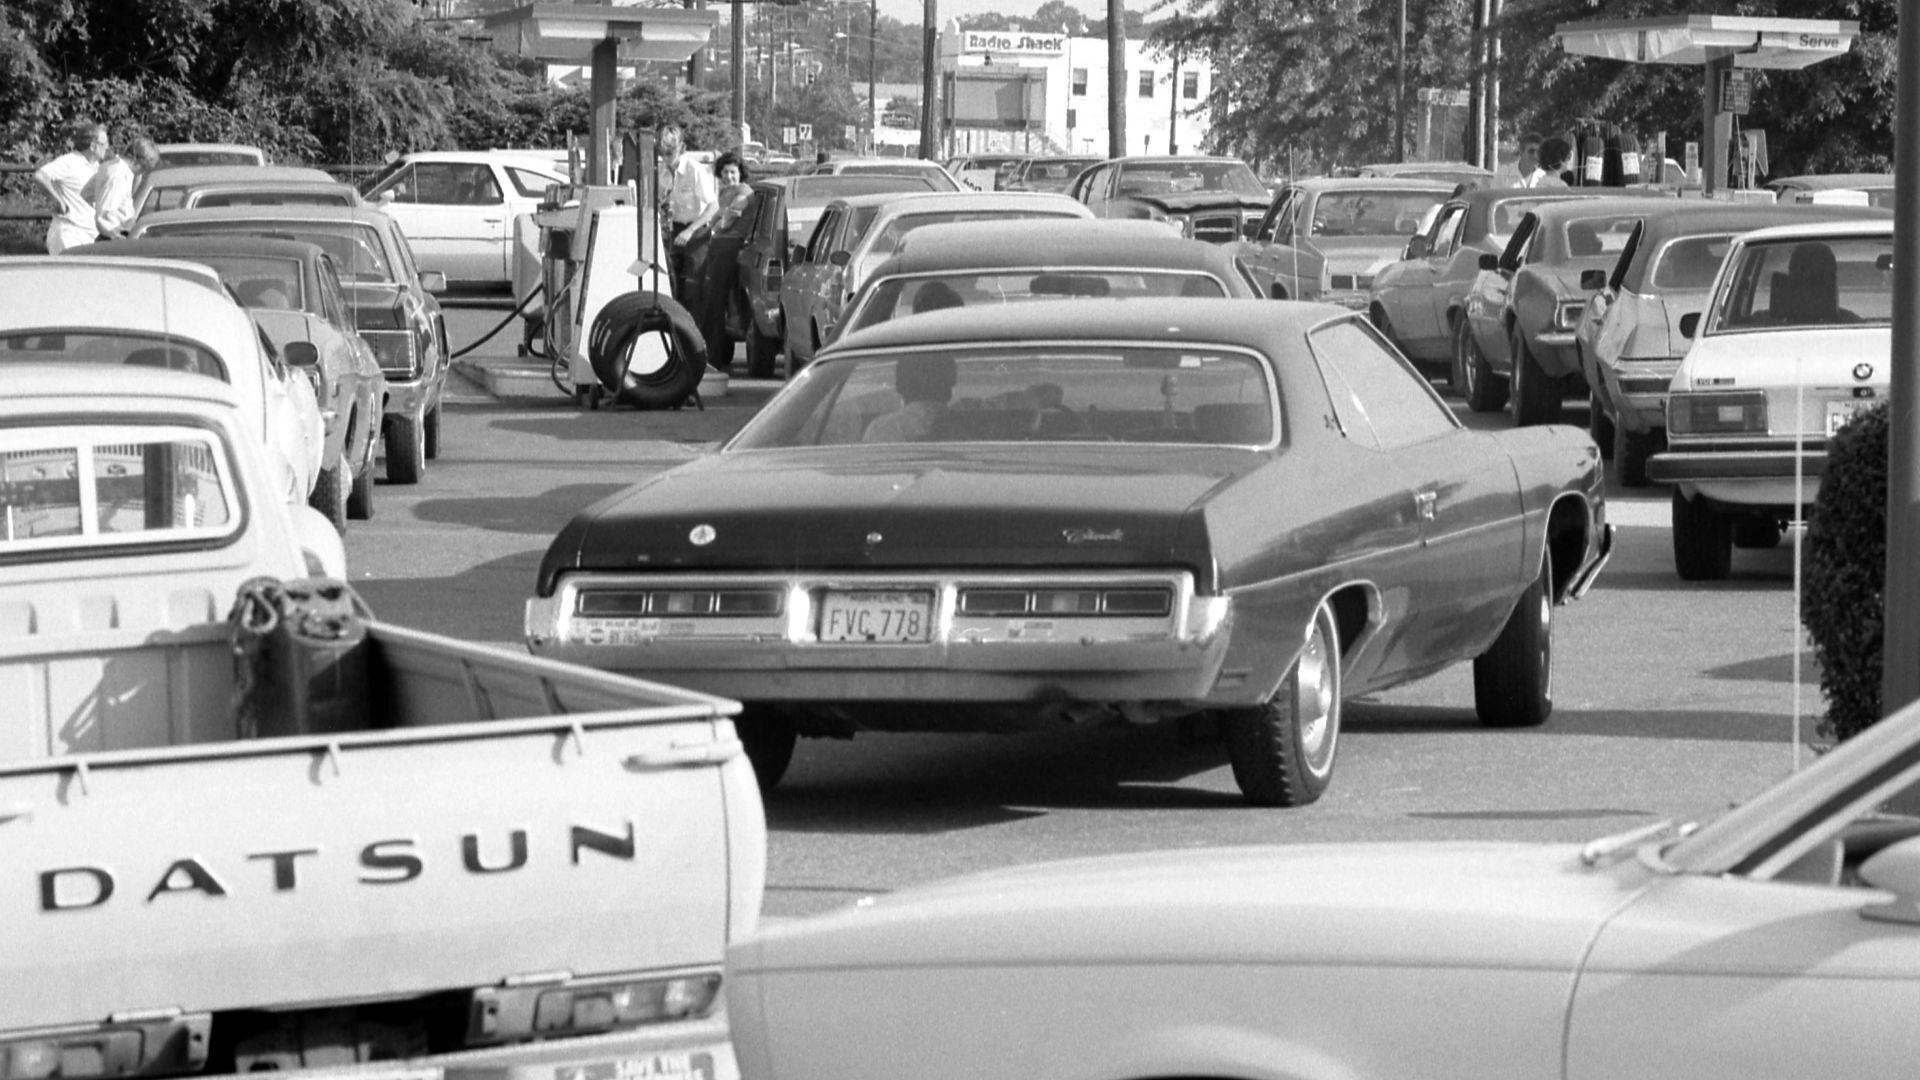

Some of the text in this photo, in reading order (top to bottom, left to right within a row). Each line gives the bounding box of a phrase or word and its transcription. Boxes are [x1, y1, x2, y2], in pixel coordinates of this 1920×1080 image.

[969, 34, 1064, 51] Radio Shack
[1799, 33, 1839, 48] Serve
[830, 608, 920, 637] FVC 778
[38, 821, 637, 912] DATSUN
